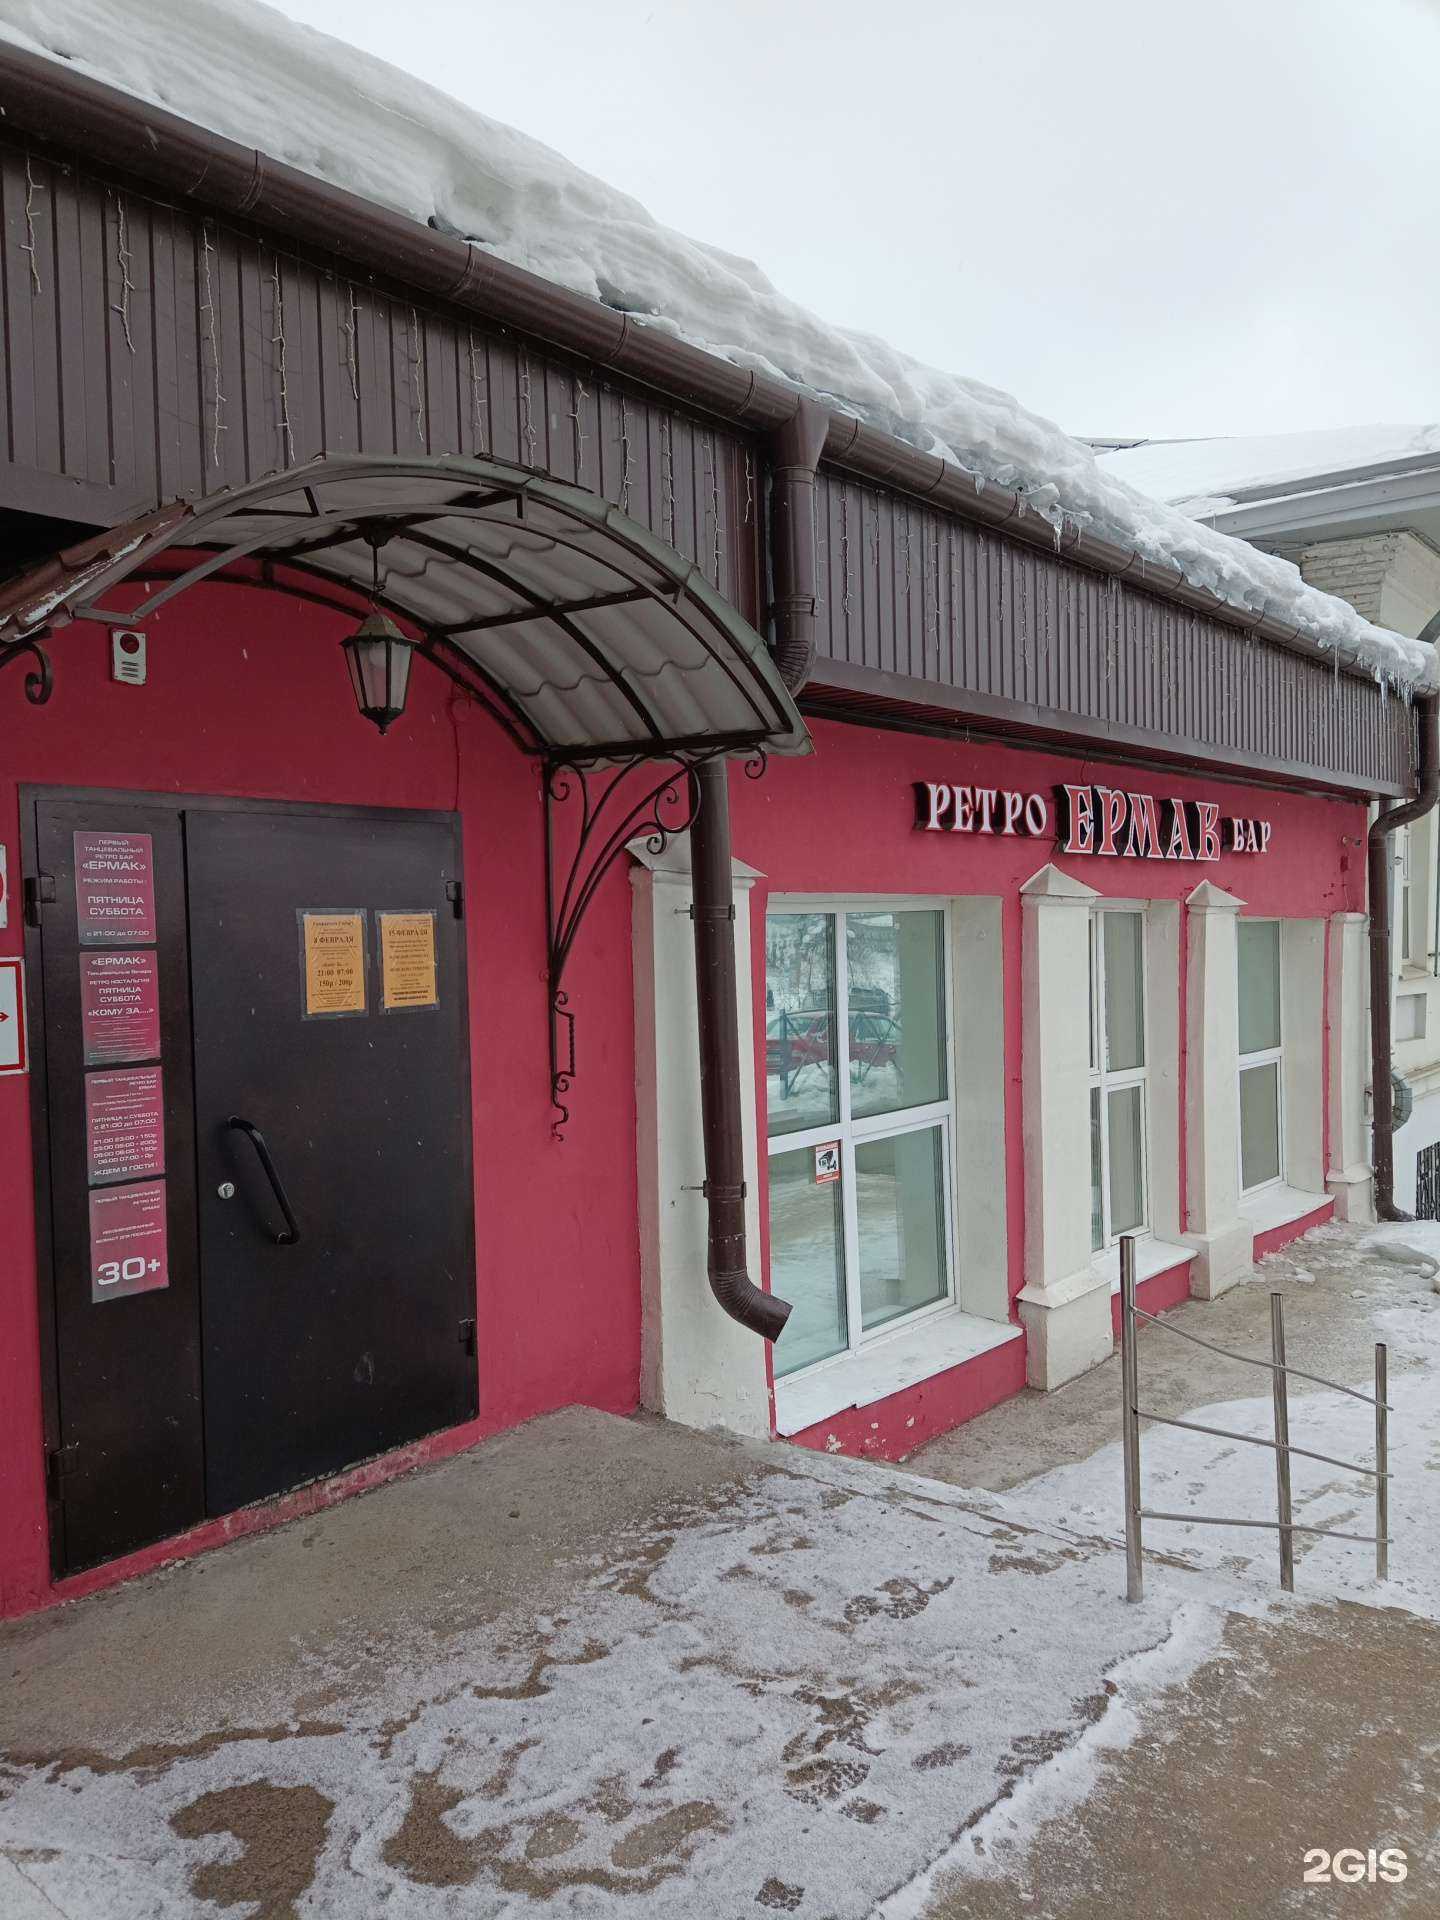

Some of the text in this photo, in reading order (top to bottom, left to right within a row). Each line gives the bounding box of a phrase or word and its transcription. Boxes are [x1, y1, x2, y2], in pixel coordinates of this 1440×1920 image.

[925, 783, 1272, 862] РЕТРО ЕРМАК БАР
[82, 860, 147, 871] «ЕРМАК»
[87, 896, 145, 905] ПЯТНИЦА
[89, 907, 144, 916] СУББОТА
[91, 957, 147, 966] «ЕРМАК»
[98, 986, 142, 994] ПЯТНИЦА
[99, 994, 142, 1003] СУББОТА
[97, 1256, 161, 1286] 30+
